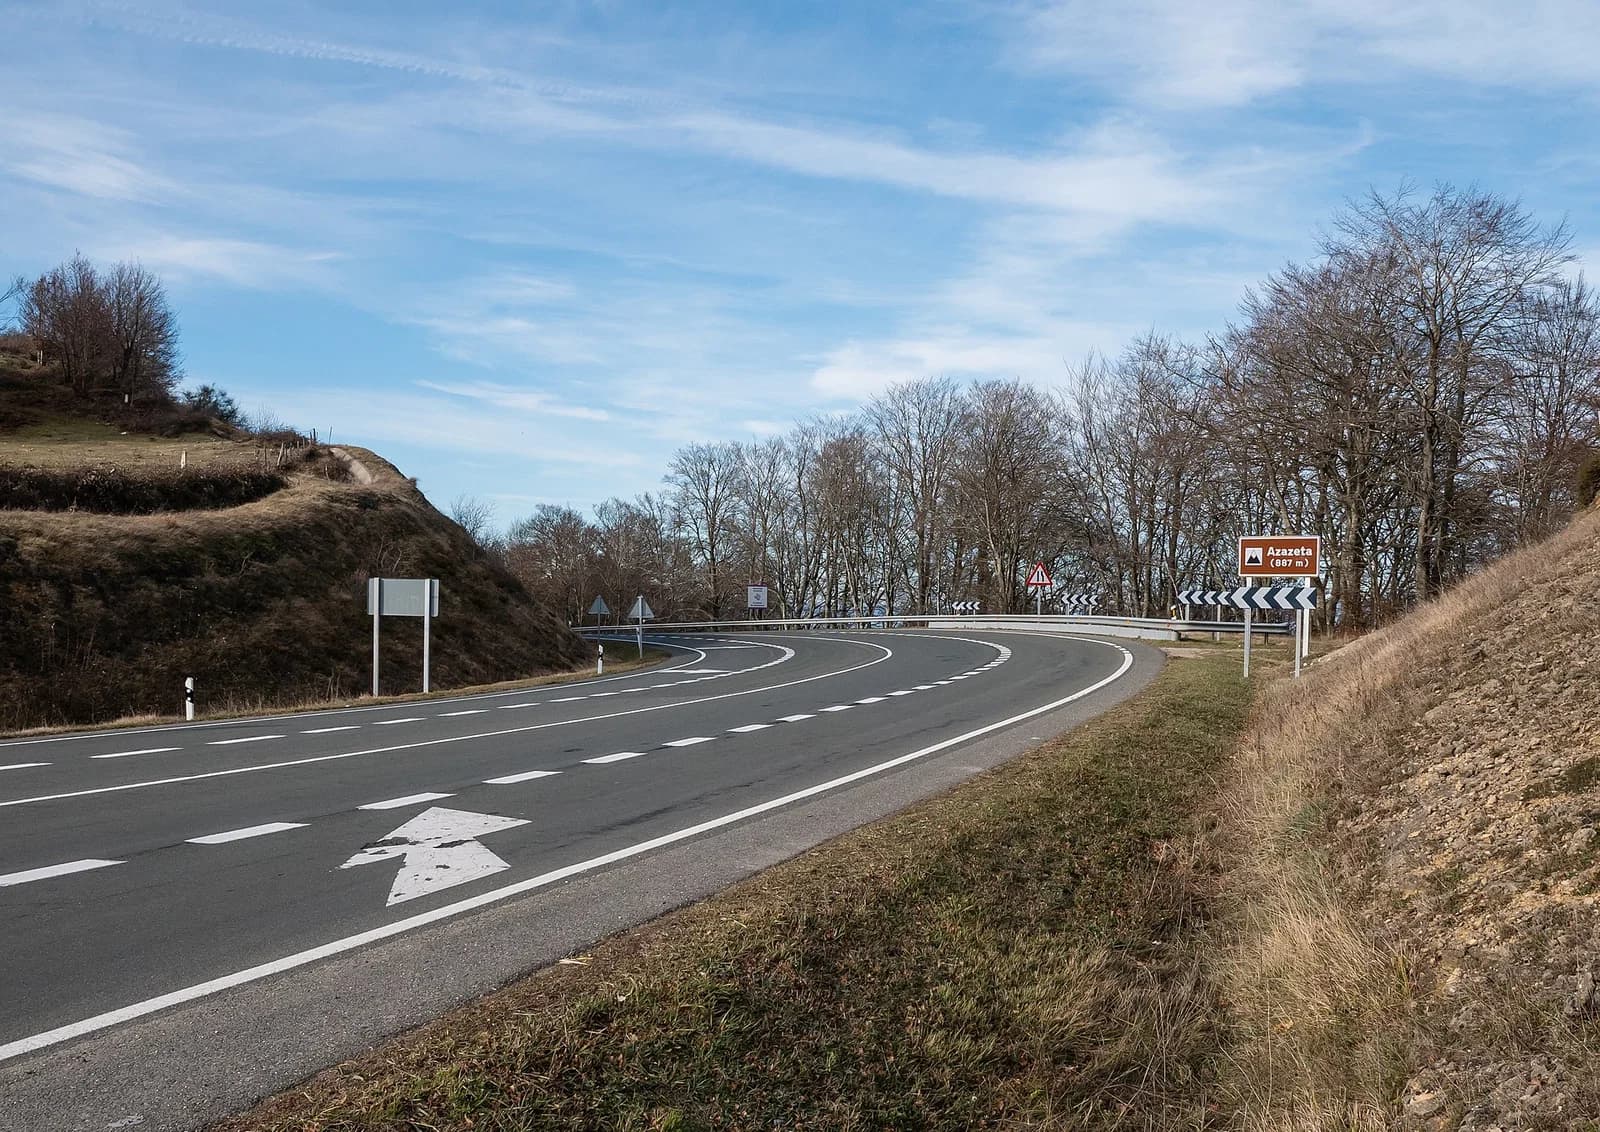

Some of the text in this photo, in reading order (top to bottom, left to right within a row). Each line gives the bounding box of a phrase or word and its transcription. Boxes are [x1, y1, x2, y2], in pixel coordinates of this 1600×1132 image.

[1267, 546, 1312, 556] Azazeta
[1270, 558, 1309, 568] (887 m)
